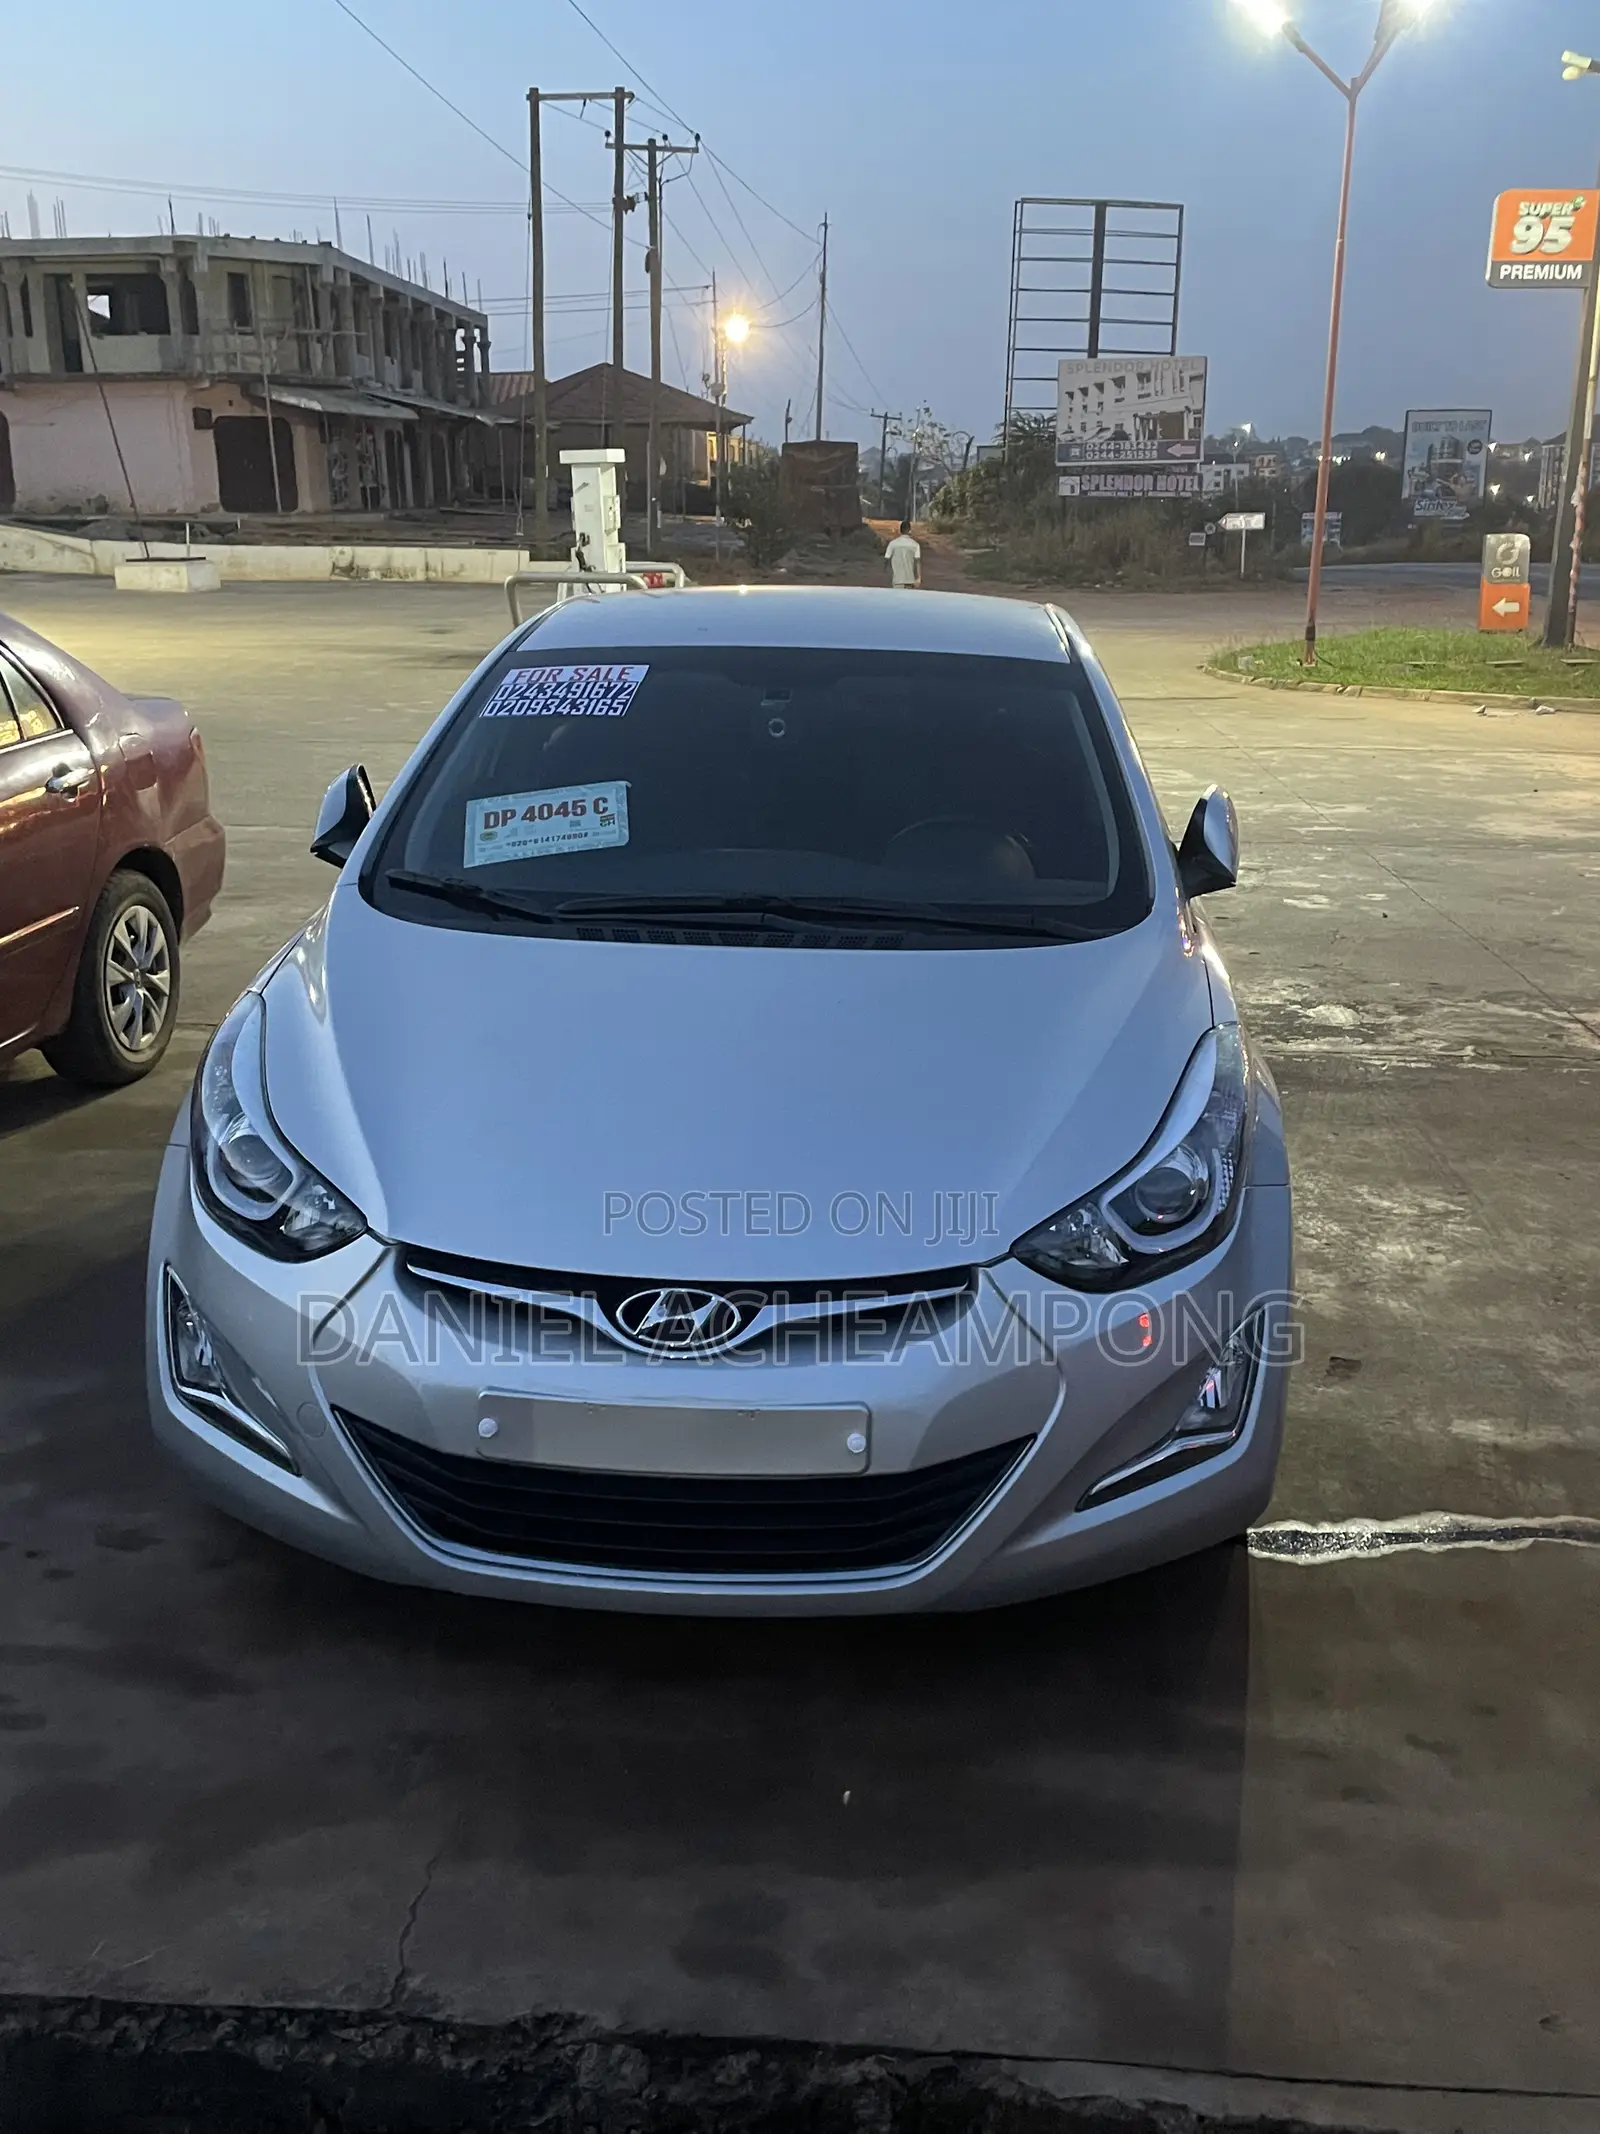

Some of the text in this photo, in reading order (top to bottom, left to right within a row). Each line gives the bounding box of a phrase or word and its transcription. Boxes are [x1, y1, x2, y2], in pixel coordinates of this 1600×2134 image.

[1518, 201, 1573, 217] SUPER
[1510, 215, 1576, 254] 95
[1499, 264, 1583, 280] PREMIUM
[1067, 359, 1198, 374] SPLENDOR HOTEL
[1081, 475, 1200, 491] SPLENDOR HOTEL
[513, 666, 635, 683] FOR SALE
[494, 681, 637, 700] 0243491672
[483, 699, 627, 716] 0209343165
[483, 797, 608, 829] DP 4045 C
